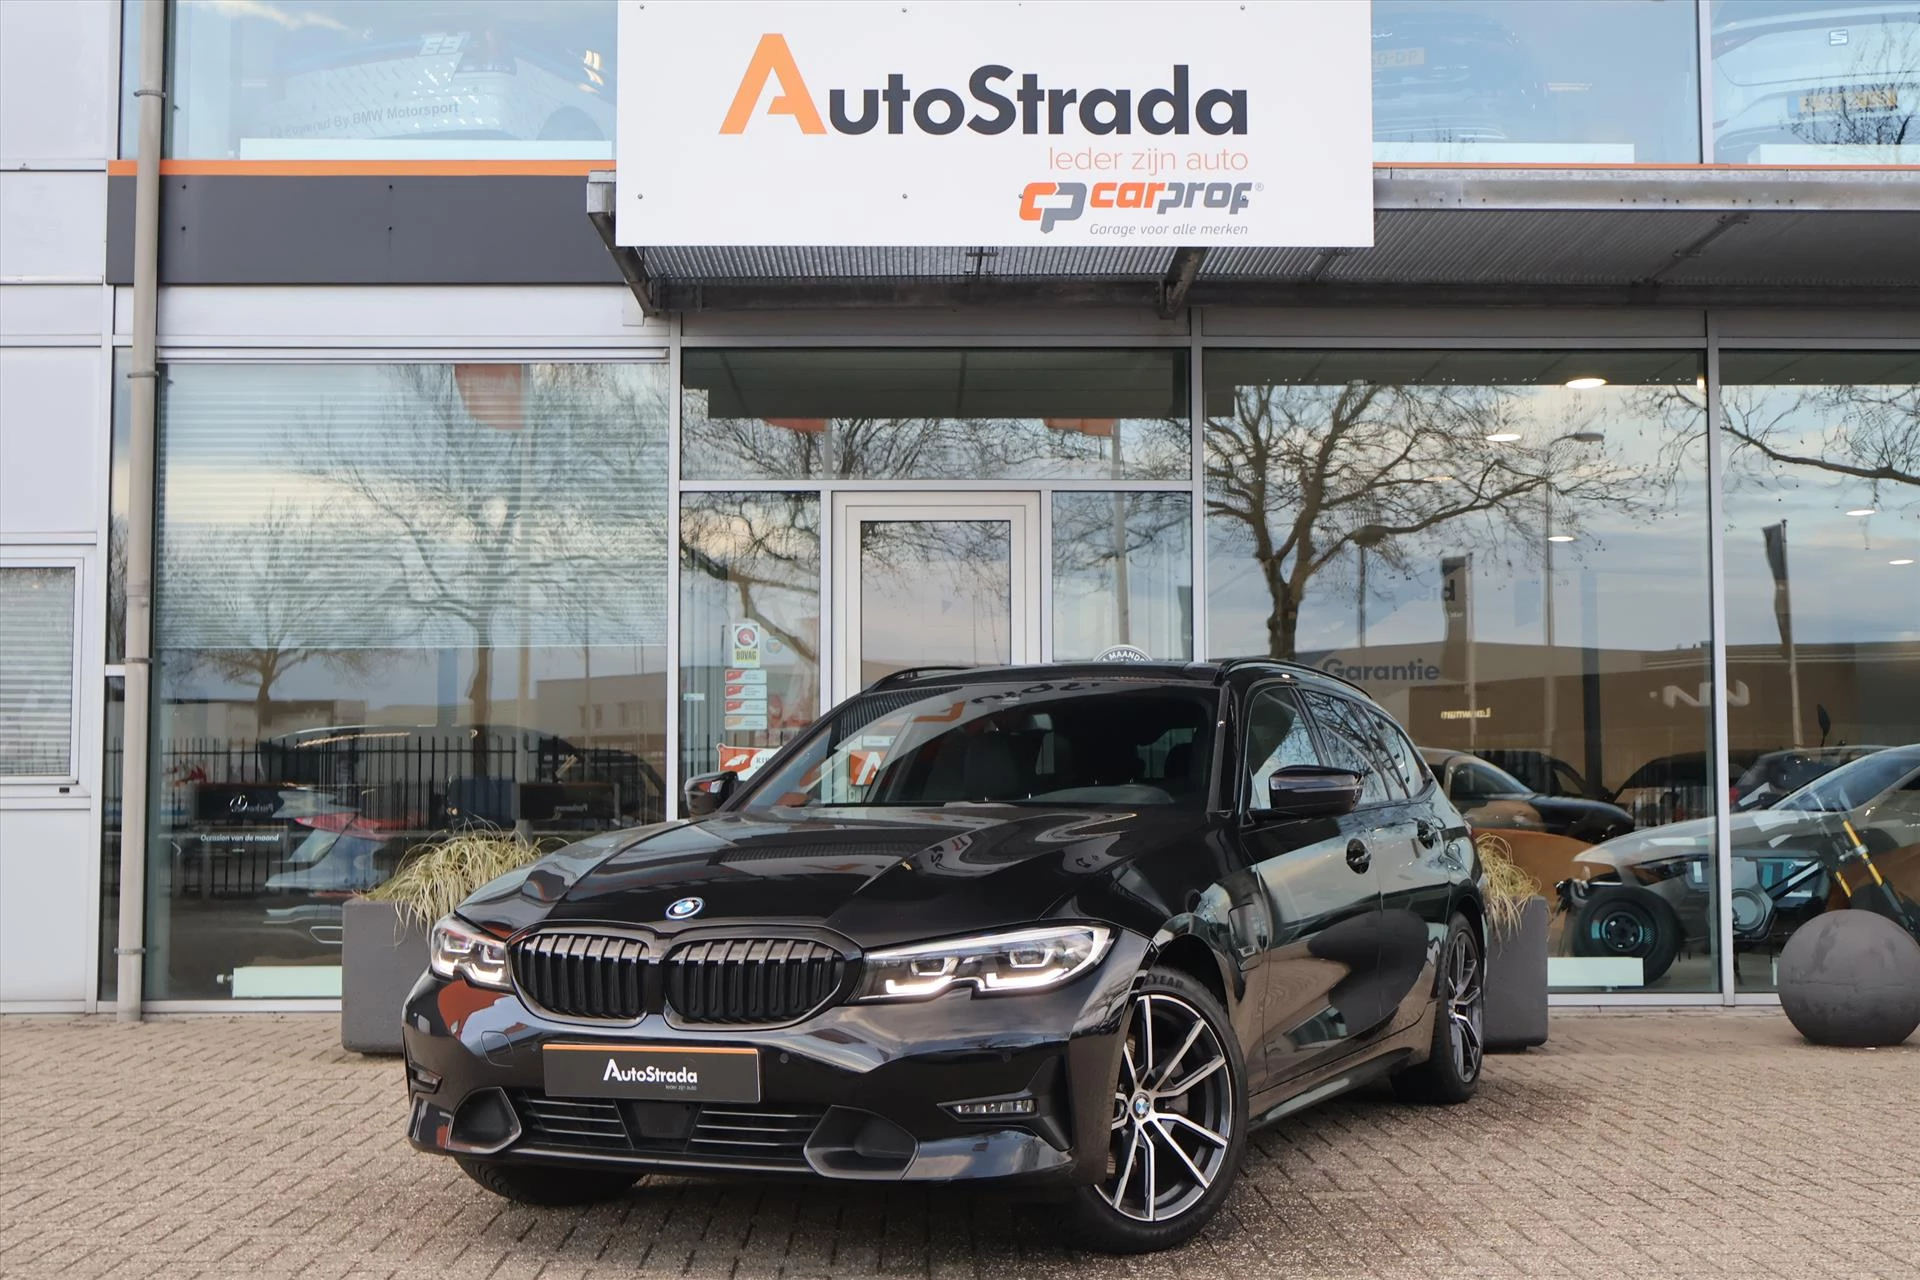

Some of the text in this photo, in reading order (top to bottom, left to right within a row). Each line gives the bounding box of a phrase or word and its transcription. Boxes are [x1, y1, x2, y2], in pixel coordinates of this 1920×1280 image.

[718, 33, 1248, 135] AutoStrada
[334, 115, 349, 128] By
[353, 110, 384, 124] BMW
[387, 102, 459, 120] Motorsport
[1049, 147, 1248, 176] Ieder zijn auto
[1090, 223, 1248, 237] Garage voor alle merken
[736, 650, 757, 661] BOVAG
[1323, 658, 1440, 681] Garantie
[200, 833, 230, 842] Occasion
[245, 833, 254, 842] de
[254, 833, 280, 842] maand
[603, 1059, 698, 1083] AutoStrada
